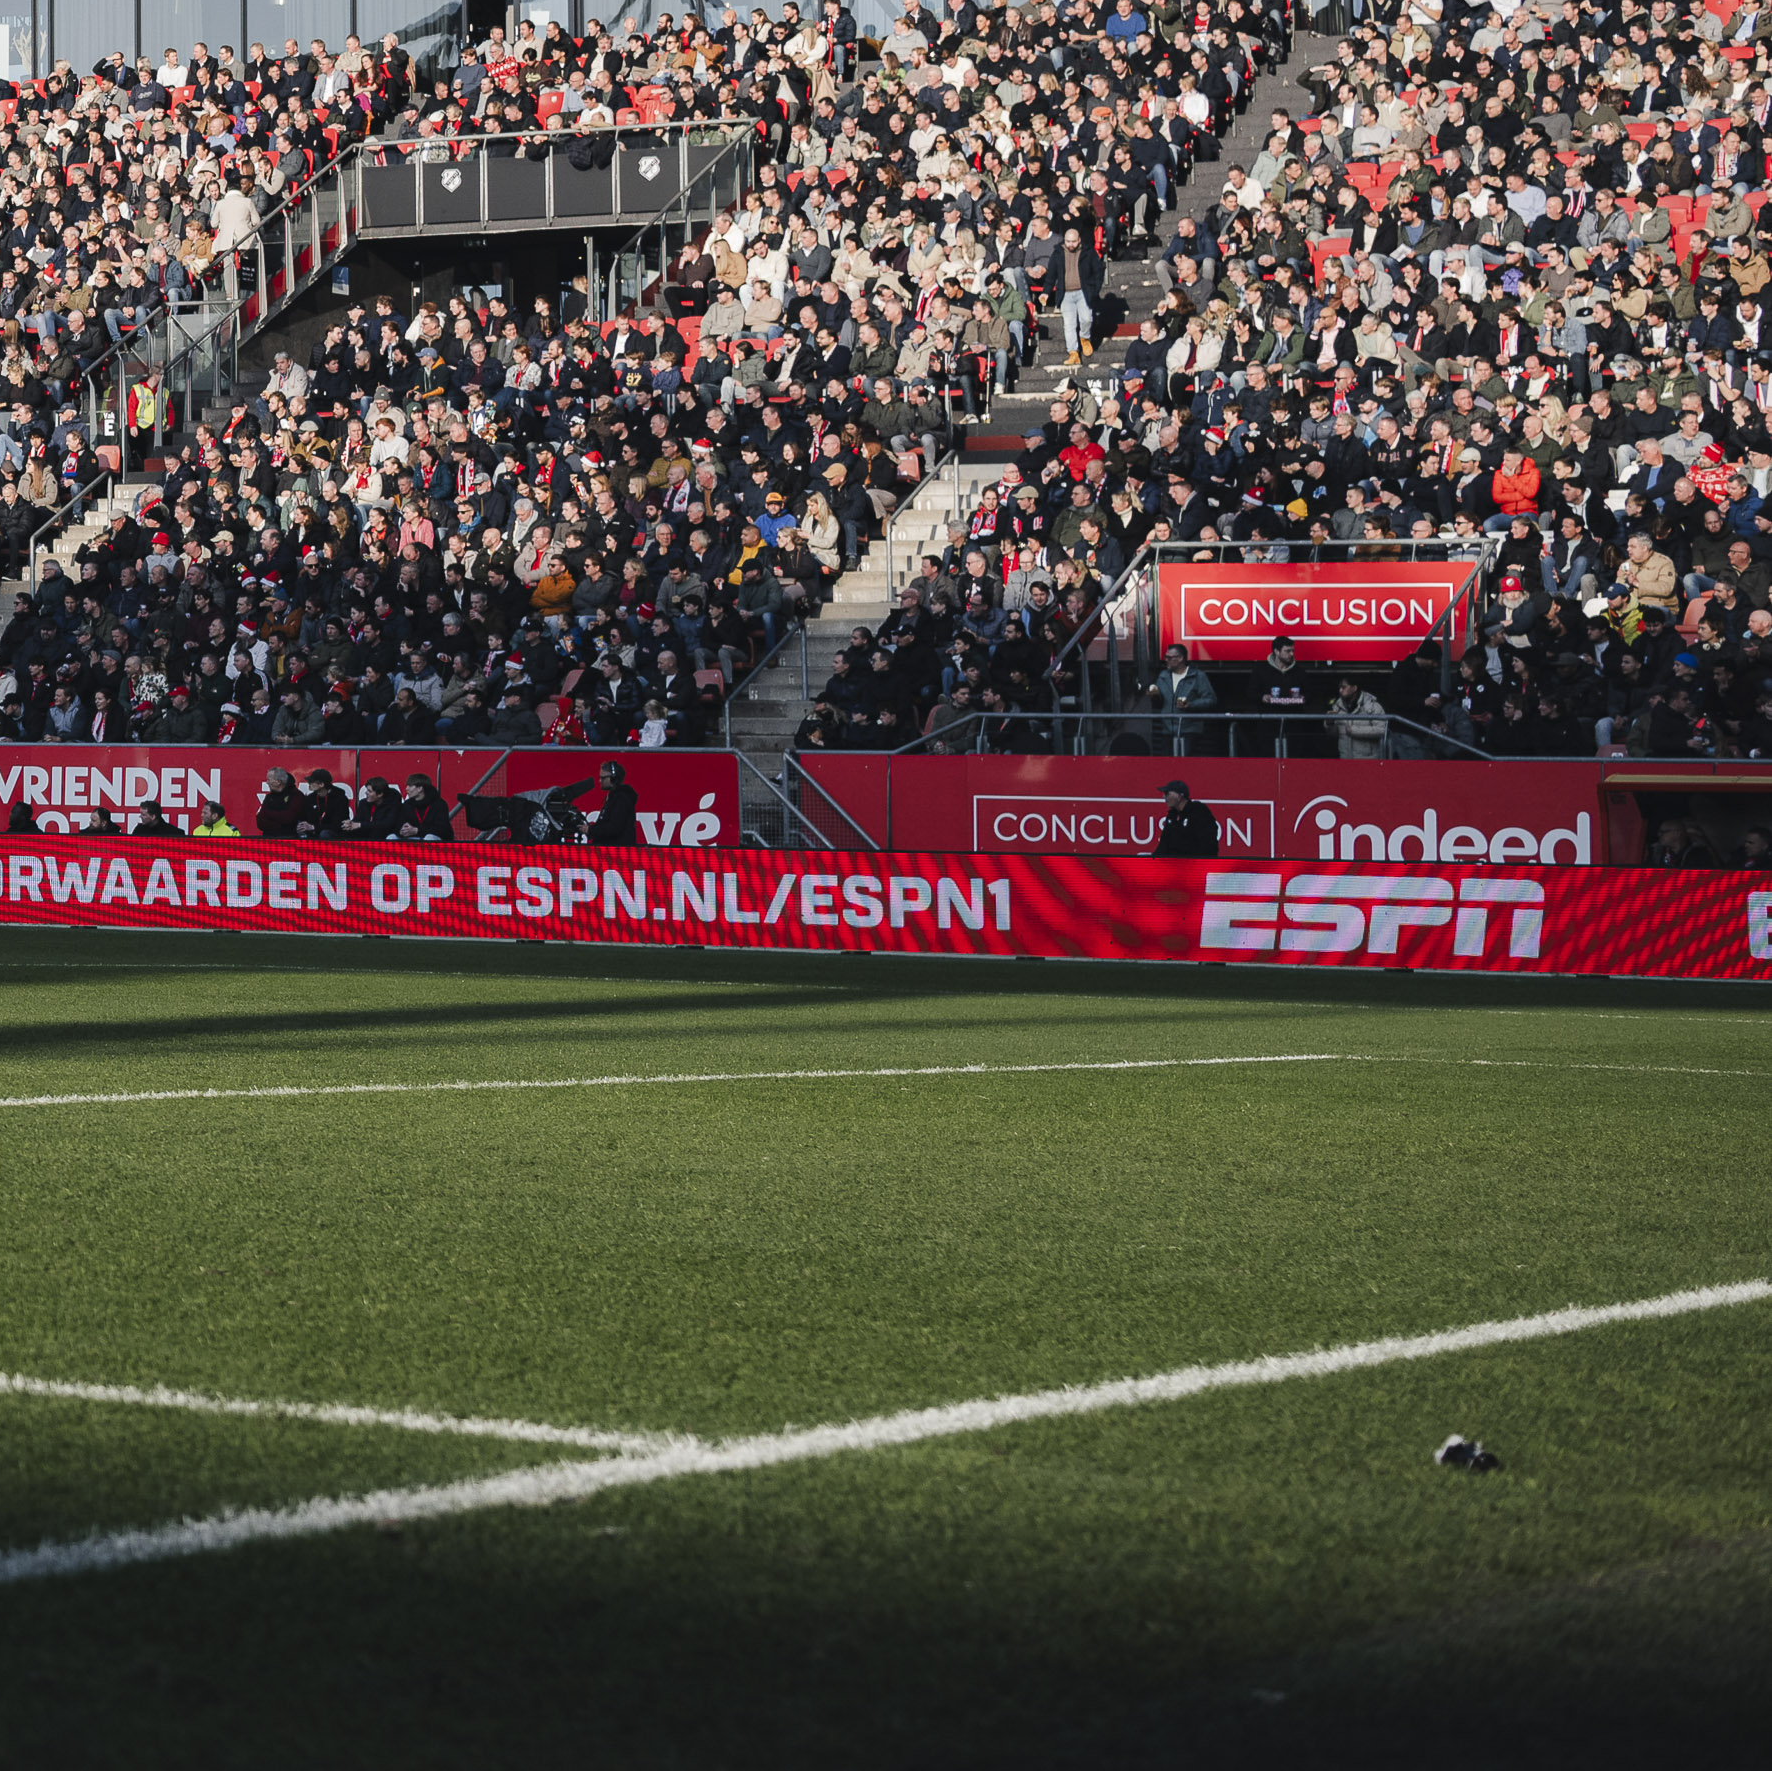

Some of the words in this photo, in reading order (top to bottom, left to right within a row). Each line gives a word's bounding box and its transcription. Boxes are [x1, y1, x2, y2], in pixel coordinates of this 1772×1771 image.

[104, 419, 115, 436] E
[1198, 596, 1435, 627] CONCLUSION
[1294, 795, 1591, 865] indeed
[370, 862, 455, 914] OP
[475, 865, 1012, 932] ESPN.NL/ESPN1
[1200, 872, 1545, 959] ESPN
